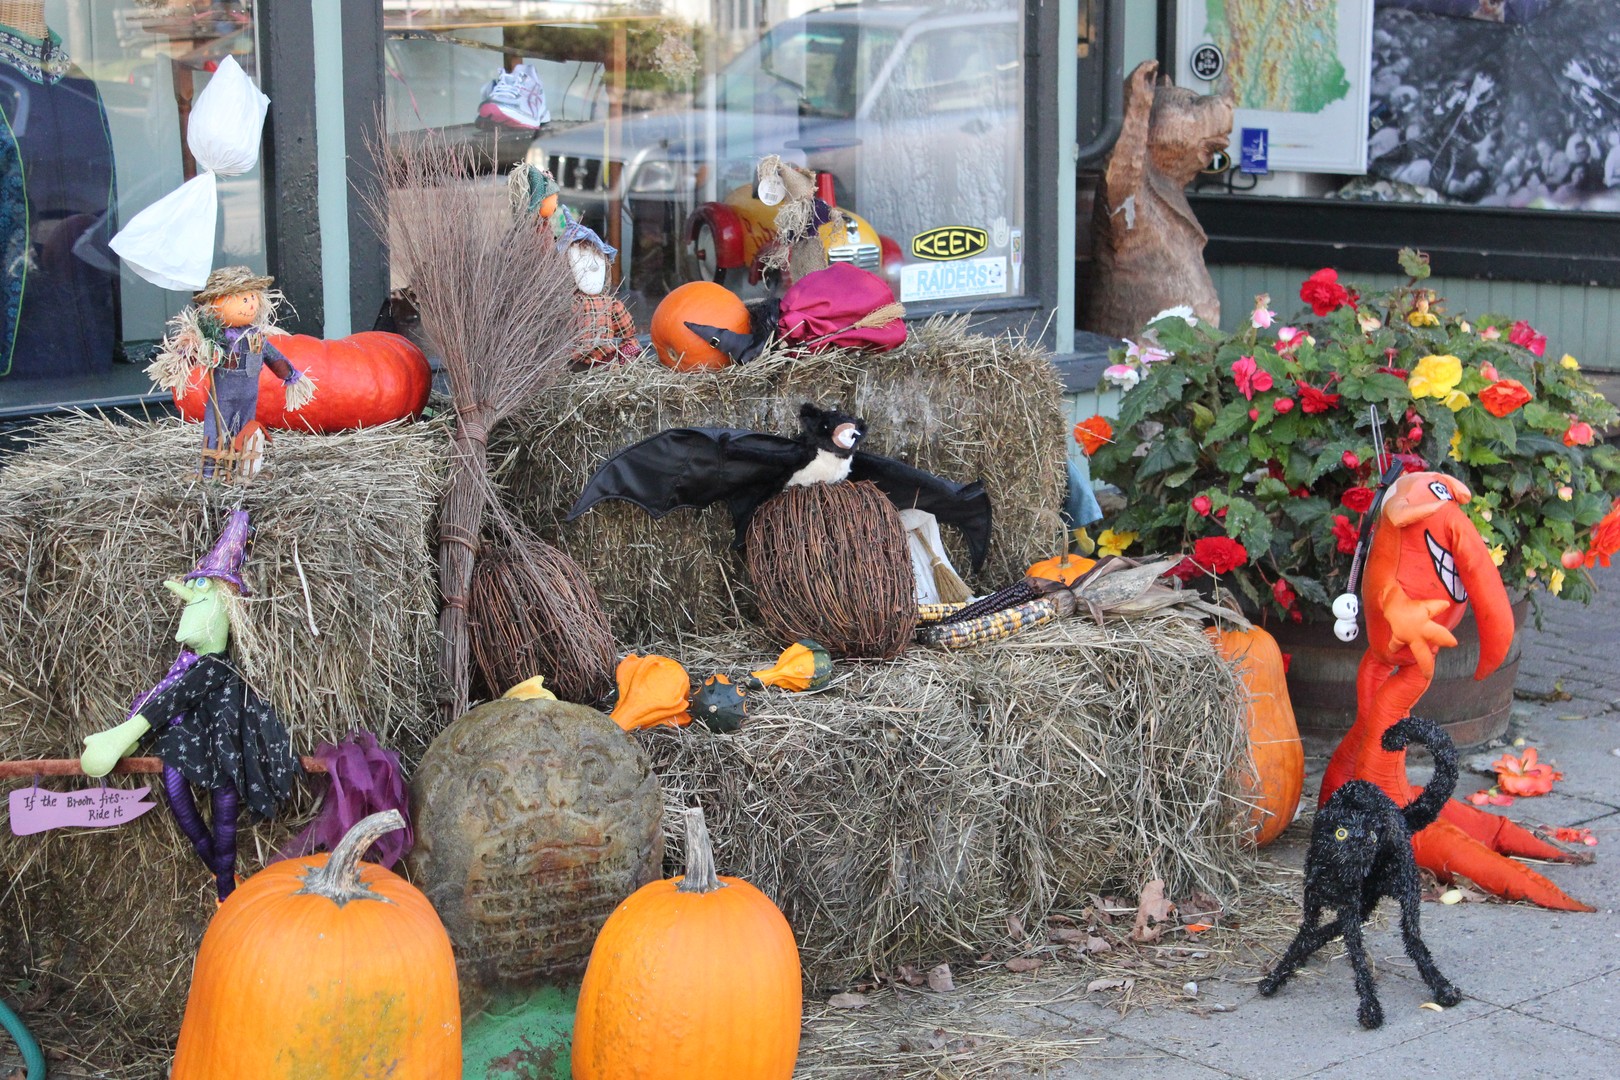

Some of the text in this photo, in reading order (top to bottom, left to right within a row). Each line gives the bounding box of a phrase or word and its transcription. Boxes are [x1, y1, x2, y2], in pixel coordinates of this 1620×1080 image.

[915, 230, 984, 256] KEEN
[917, 264, 988, 292] RAIDERS
[23, 795, 37, 811] If
[40, 794, 58, 807] the
[66, 795, 96, 808] Broom
[88, 809, 110, 821] Ride
